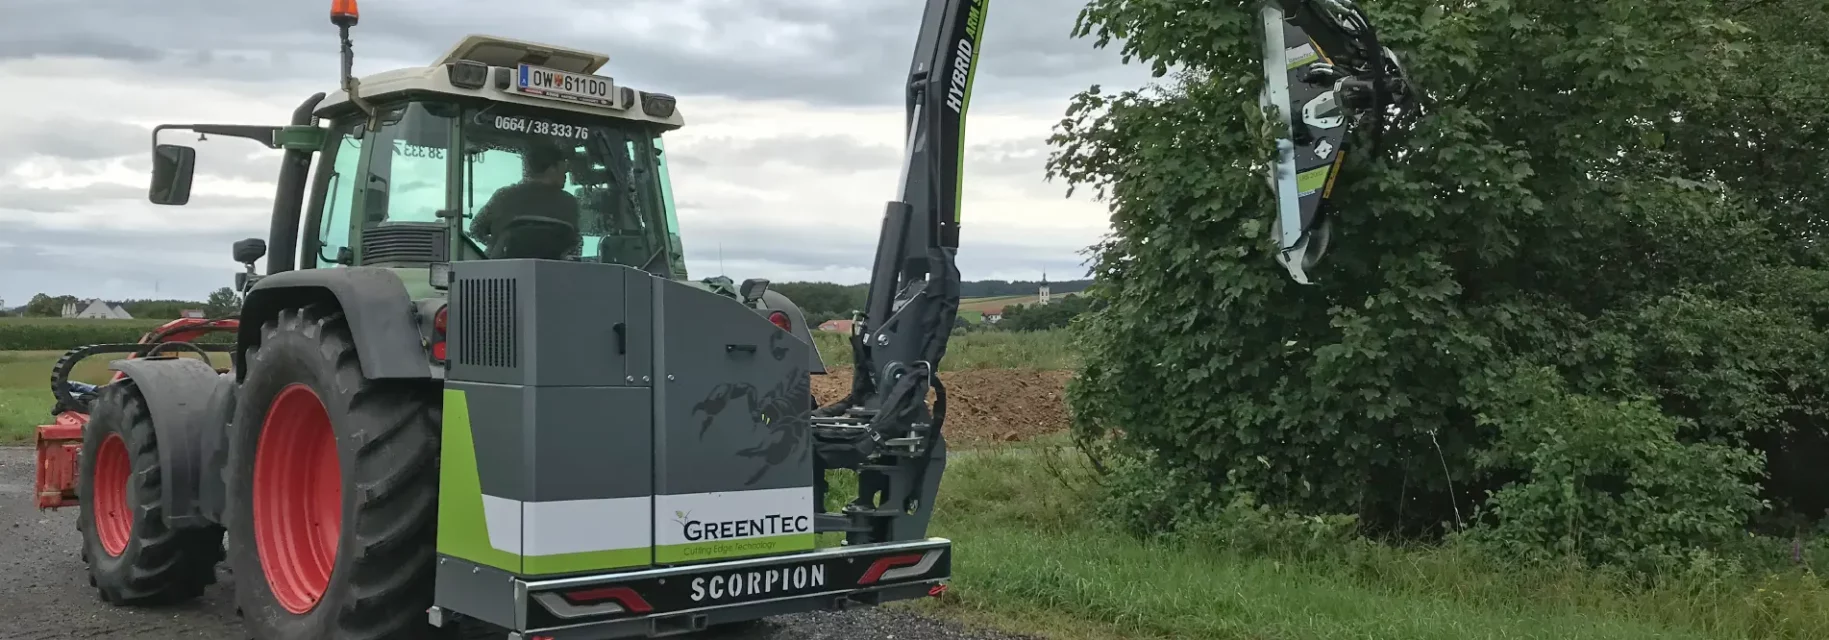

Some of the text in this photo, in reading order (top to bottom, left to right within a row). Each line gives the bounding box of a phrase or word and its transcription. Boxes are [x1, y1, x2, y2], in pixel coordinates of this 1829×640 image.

[946, 38, 972, 114] HYBRID
[965, 5, 980, 39] ARM
[533, 70, 607, 97] OW 611DO
[495, 115, 525, 132] 0664
[534, 121, 549, 135] 38
[550, 122, 572, 138] 333
[575, 126, 589, 140] 76
[683, 541, 777, 556] Cutting Edge Technology
[690, 563, 825, 602] SCORPION
